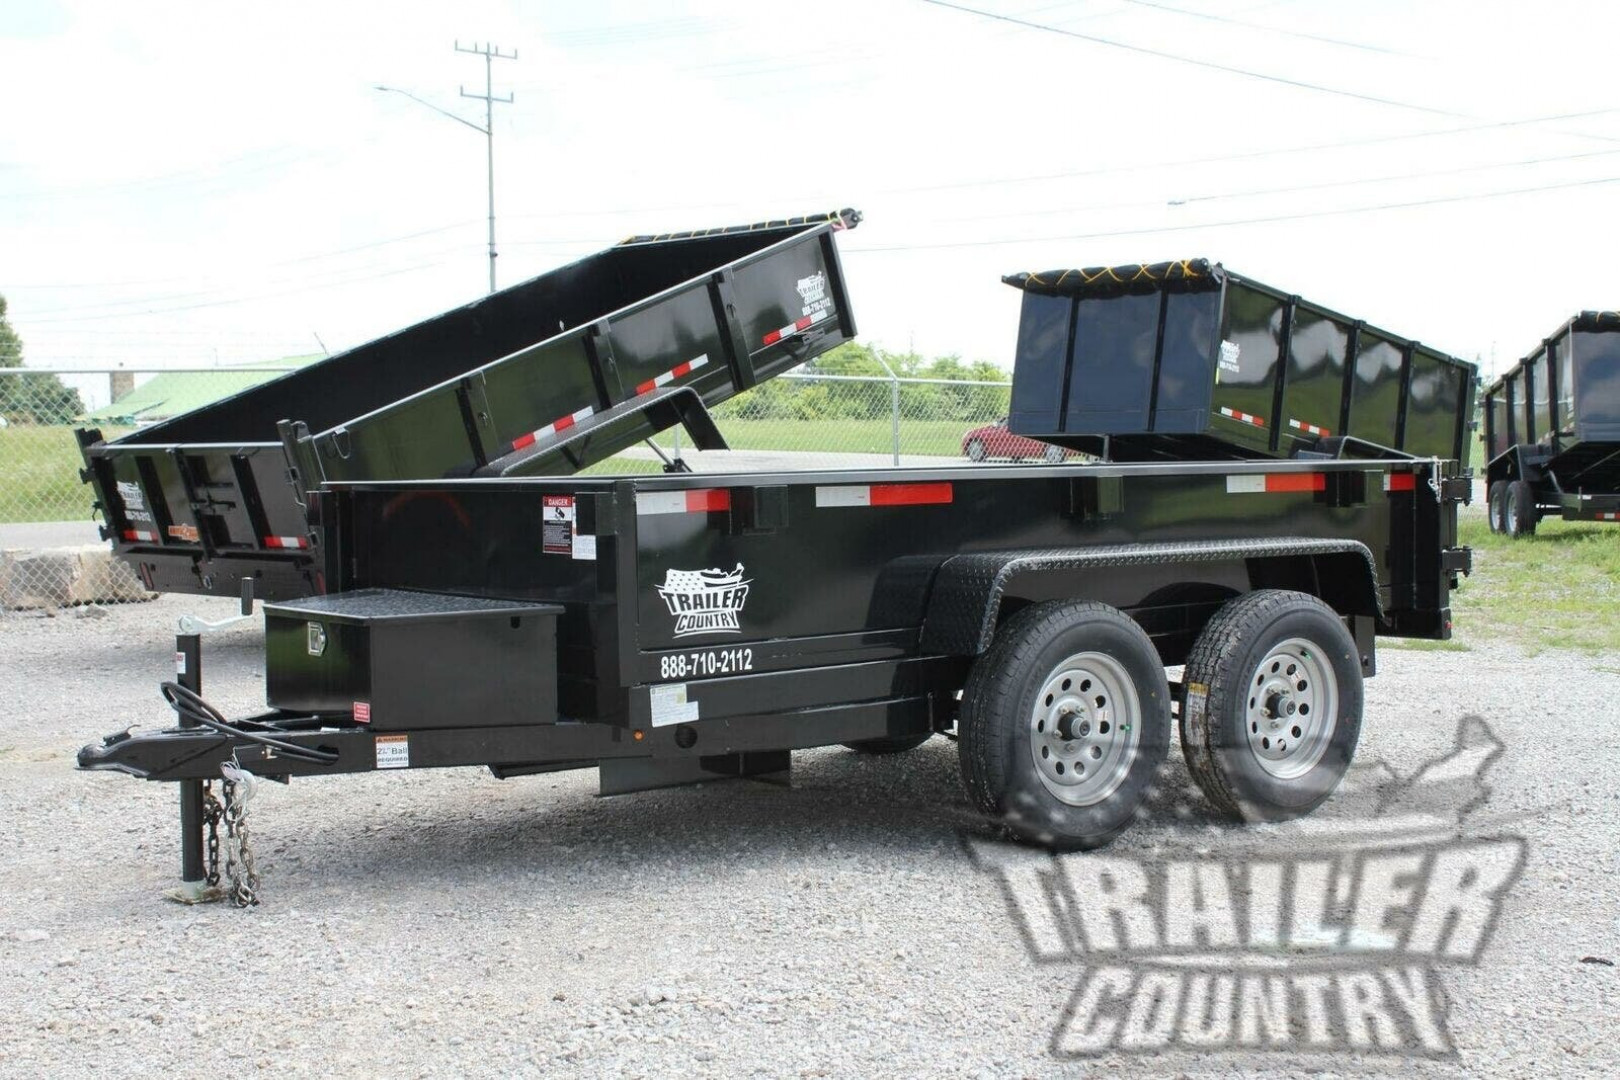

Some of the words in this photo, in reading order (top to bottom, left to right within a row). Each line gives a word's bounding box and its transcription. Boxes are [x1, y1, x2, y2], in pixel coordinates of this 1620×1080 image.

[548, 498, 568, 506] DANGER
[660, 586, 747, 615] TRAILER
[676, 612, 739, 632] COUNTRY
[660, 648, 753, 679] 888-710-2112
[391, 746, 408, 755] Ball
